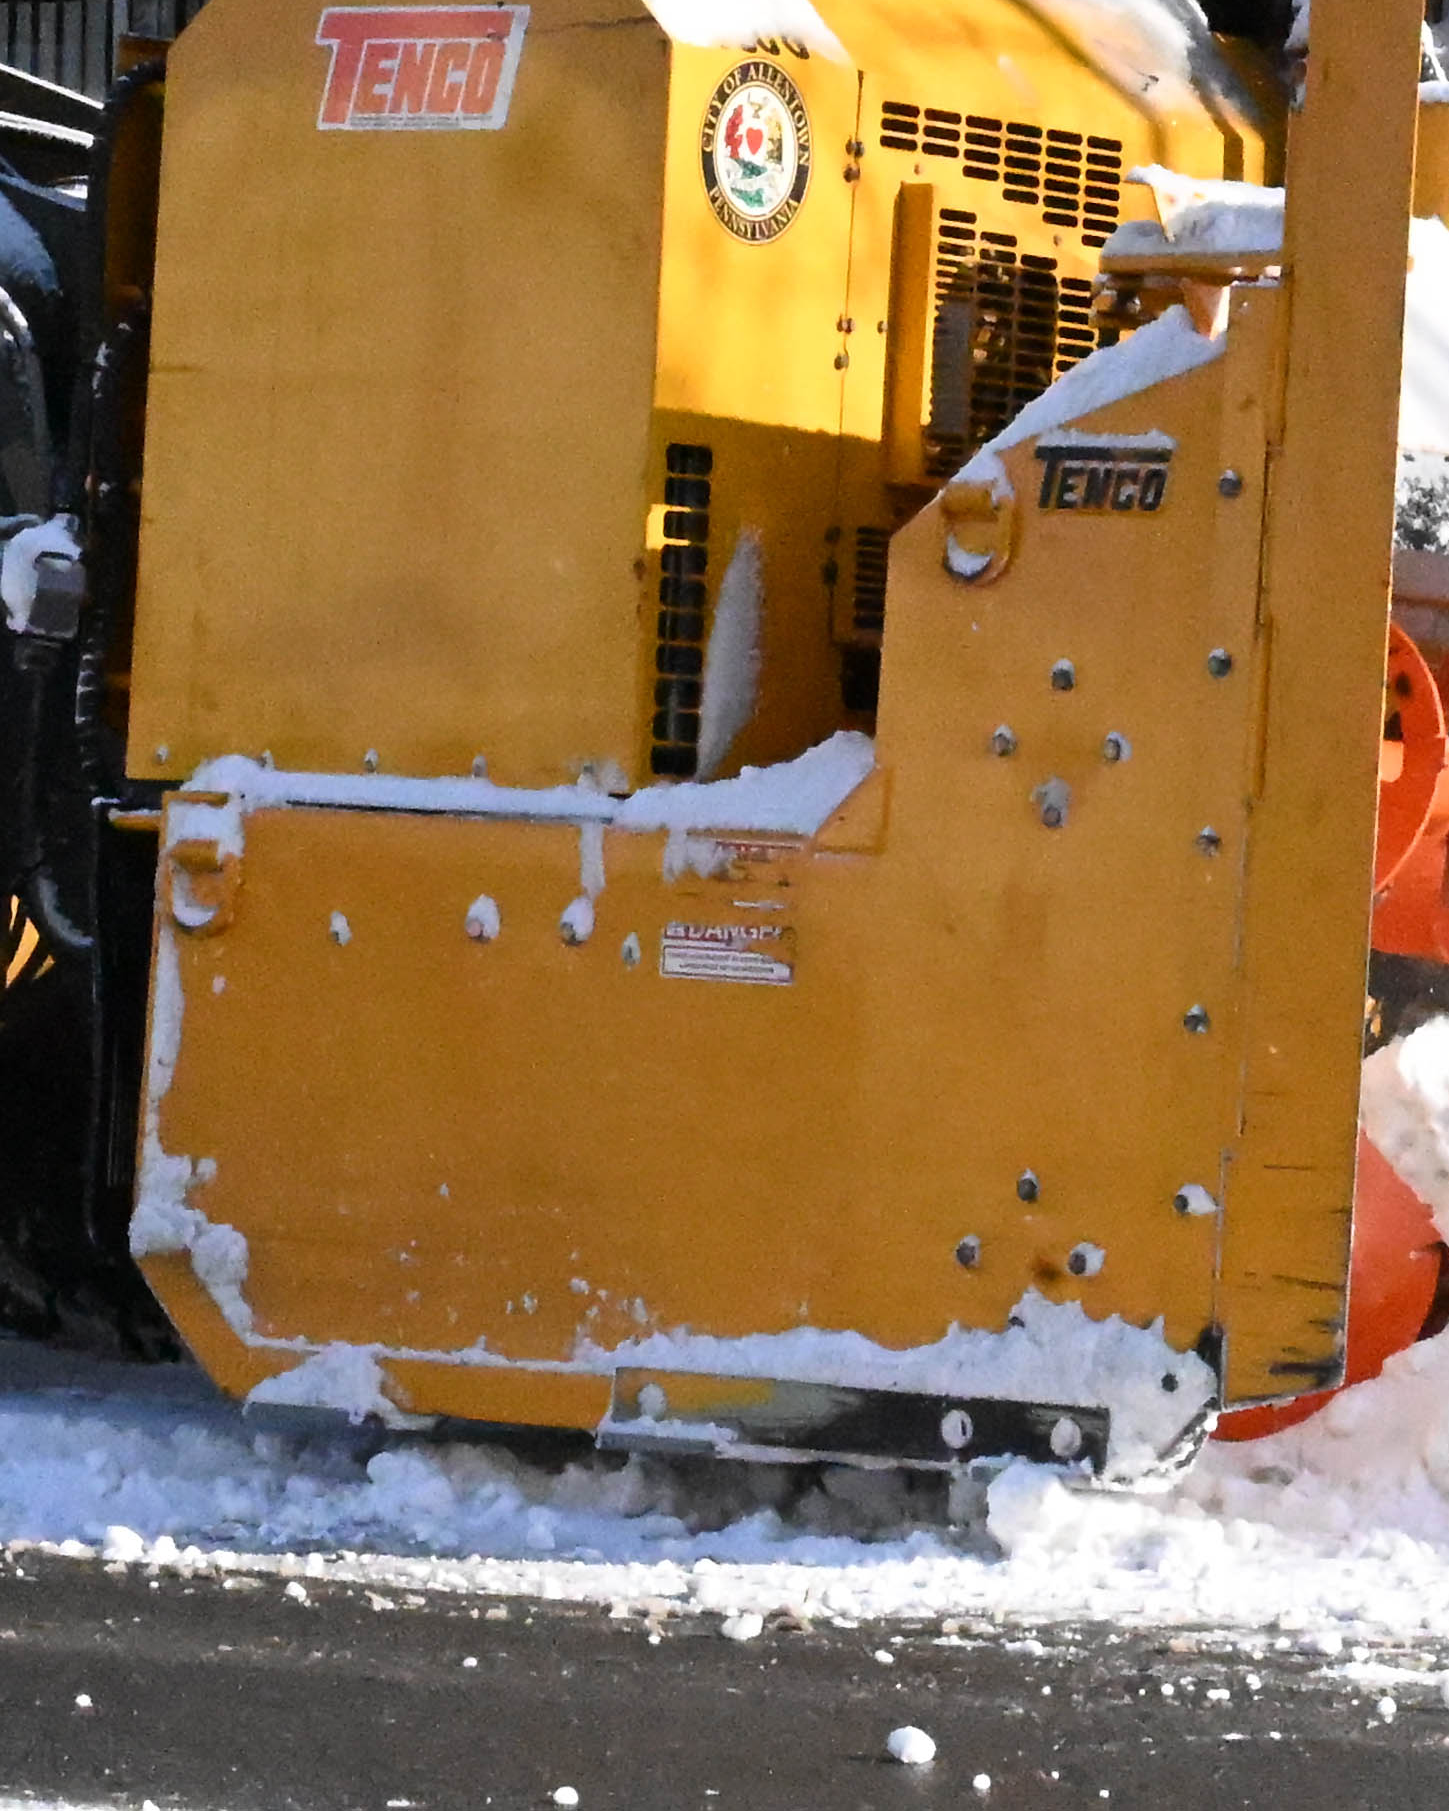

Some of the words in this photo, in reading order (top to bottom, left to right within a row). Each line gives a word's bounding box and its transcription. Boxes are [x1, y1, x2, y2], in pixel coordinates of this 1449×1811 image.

[316, 8, 522, 127] TENCO
[703, 96, 722, 152] CITY
[723, 69, 743, 94] OF
[1035, 445, 1173, 512] TENCO
